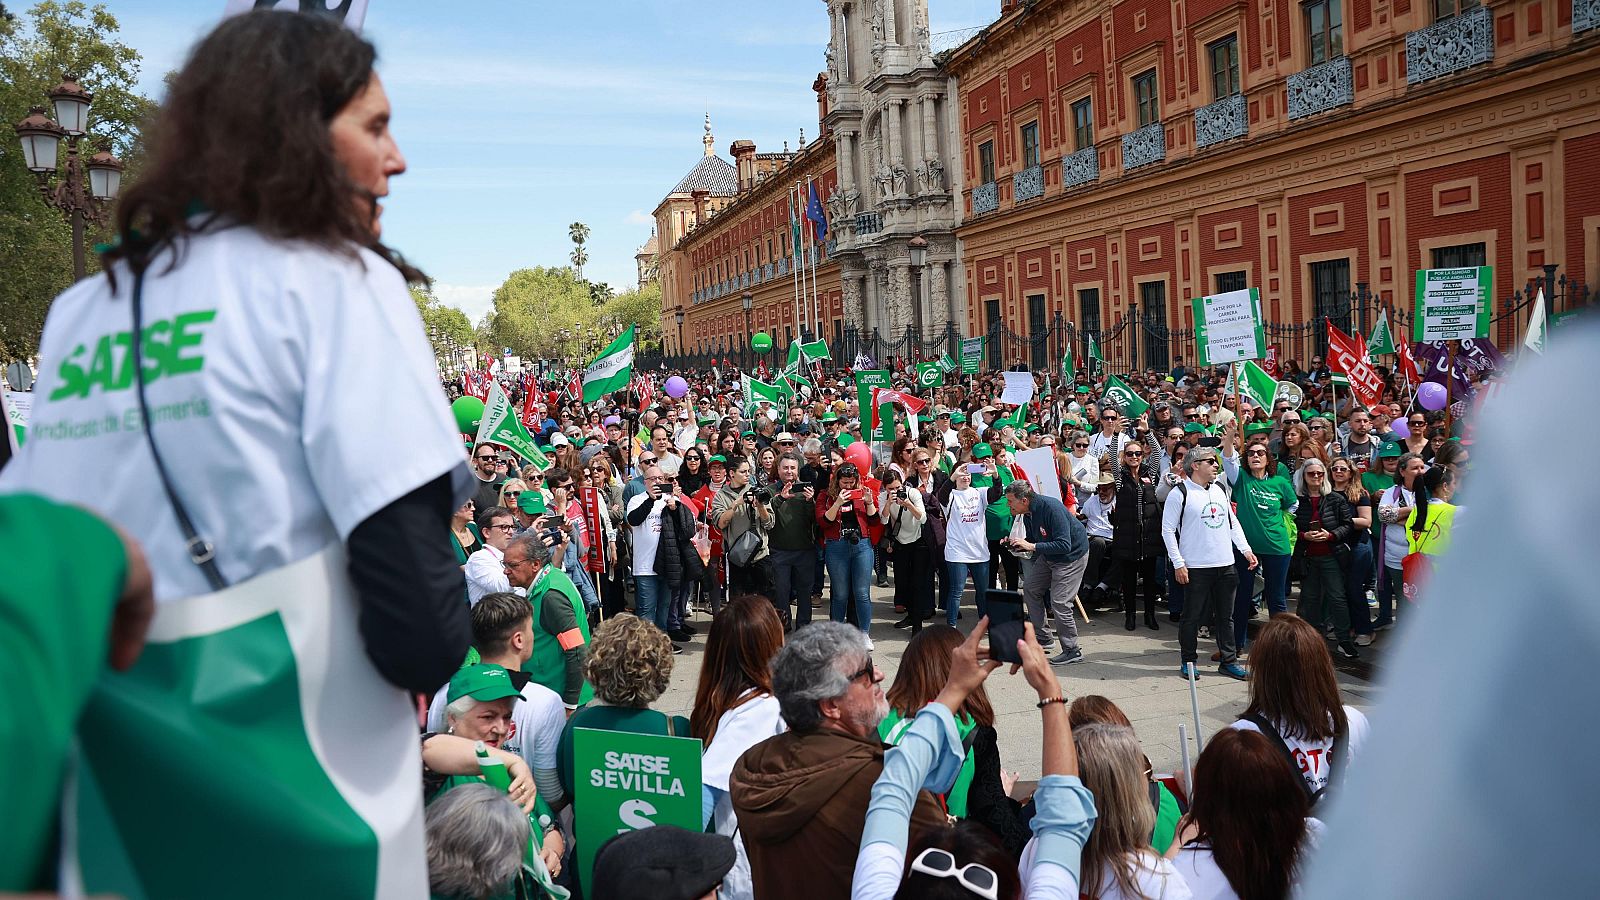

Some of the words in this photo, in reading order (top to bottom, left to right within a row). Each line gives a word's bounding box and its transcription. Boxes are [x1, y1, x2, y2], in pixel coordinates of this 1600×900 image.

[48, 310, 217, 402] SATSE
[1461, 338, 1485, 357] GT
[604, 751, 670, 775] SATSE
[1291, 748, 1324, 775] GT
[590, 769, 685, 797] SEVILLA
